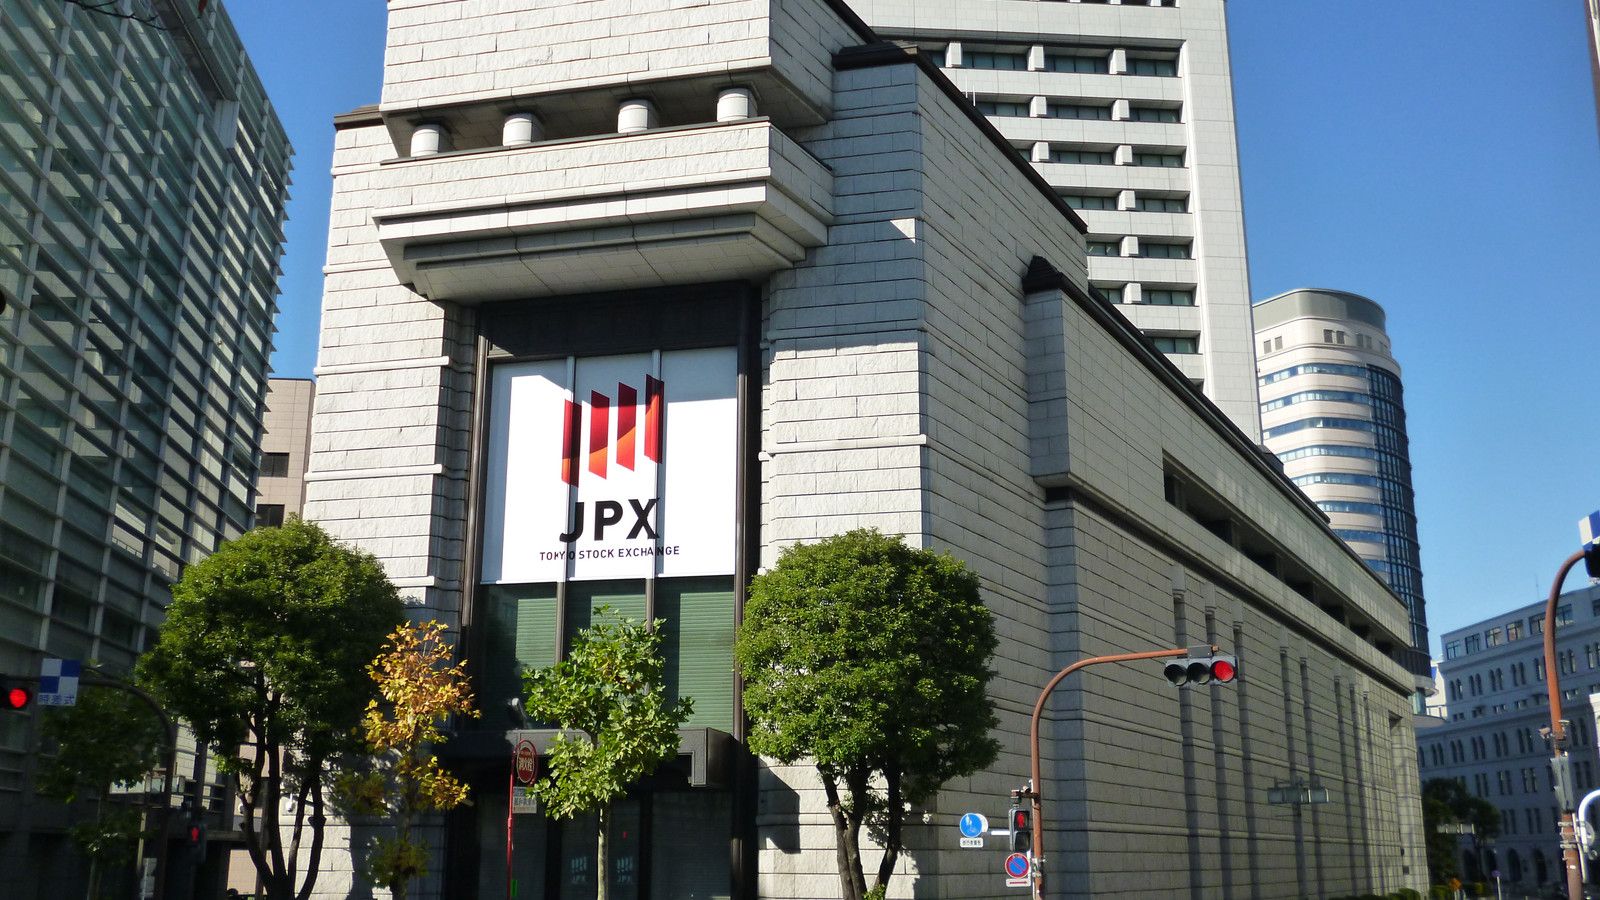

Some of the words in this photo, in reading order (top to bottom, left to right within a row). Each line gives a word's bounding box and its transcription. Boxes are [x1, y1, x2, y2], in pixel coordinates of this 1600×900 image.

[559, 497, 660, 543] JPX
[540, 551, 575, 561] TOKYO
[579, 549, 614, 559] STOCK
[618, 546, 680, 558] EXCHANGE
